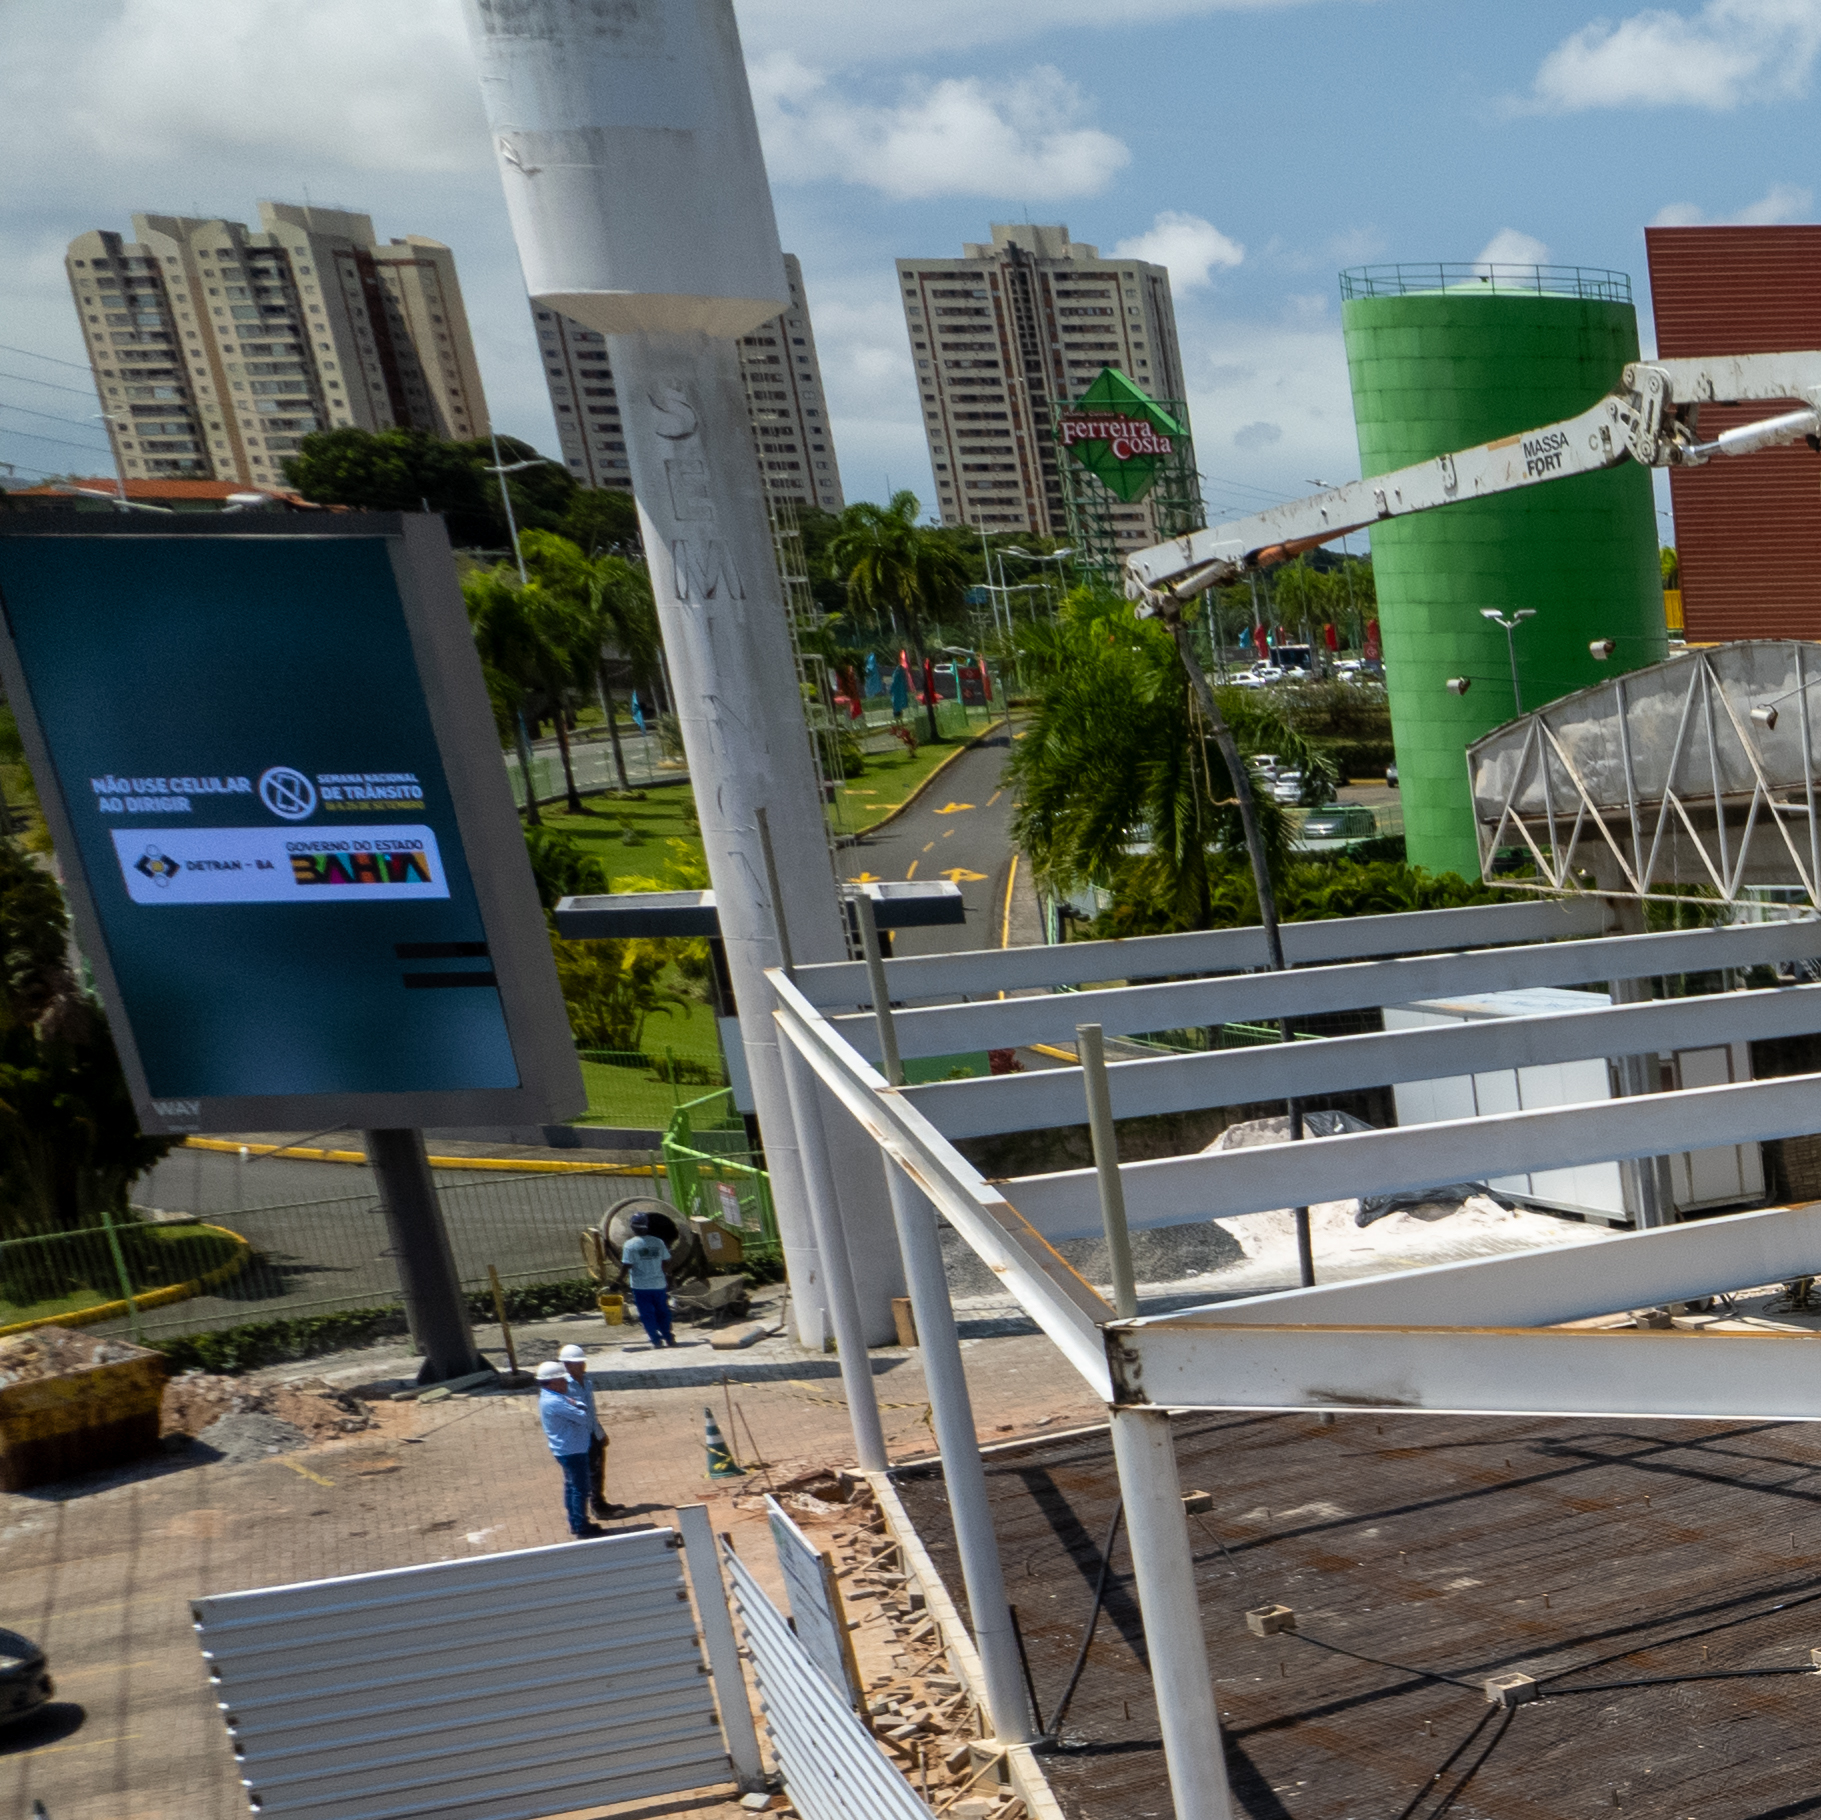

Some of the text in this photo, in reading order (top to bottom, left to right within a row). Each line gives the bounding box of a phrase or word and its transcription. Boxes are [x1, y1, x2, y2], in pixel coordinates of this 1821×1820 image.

[1060, 414, 1154, 444] Ferreira
[1112, 434, 1172, 460] Costa
[1523, 431, 1570, 458] MASSA
[1527, 452, 1562, 476] FORT
[90, 775, 253, 793] NÃO USE CELULAR
[320, 783, 424, 799] DE TRÂNSITO
[99, 796, 193, 812] AO DIRIGIR
[286, 840, 423, 851] GOVERNO DO ESTADO
[185, 860, 242, 871] DETRAN
[254, 860, 275, 870] BA
[289, 852, 432, 885] BAHIA
[151, 1100, 199, 1116] WAY
